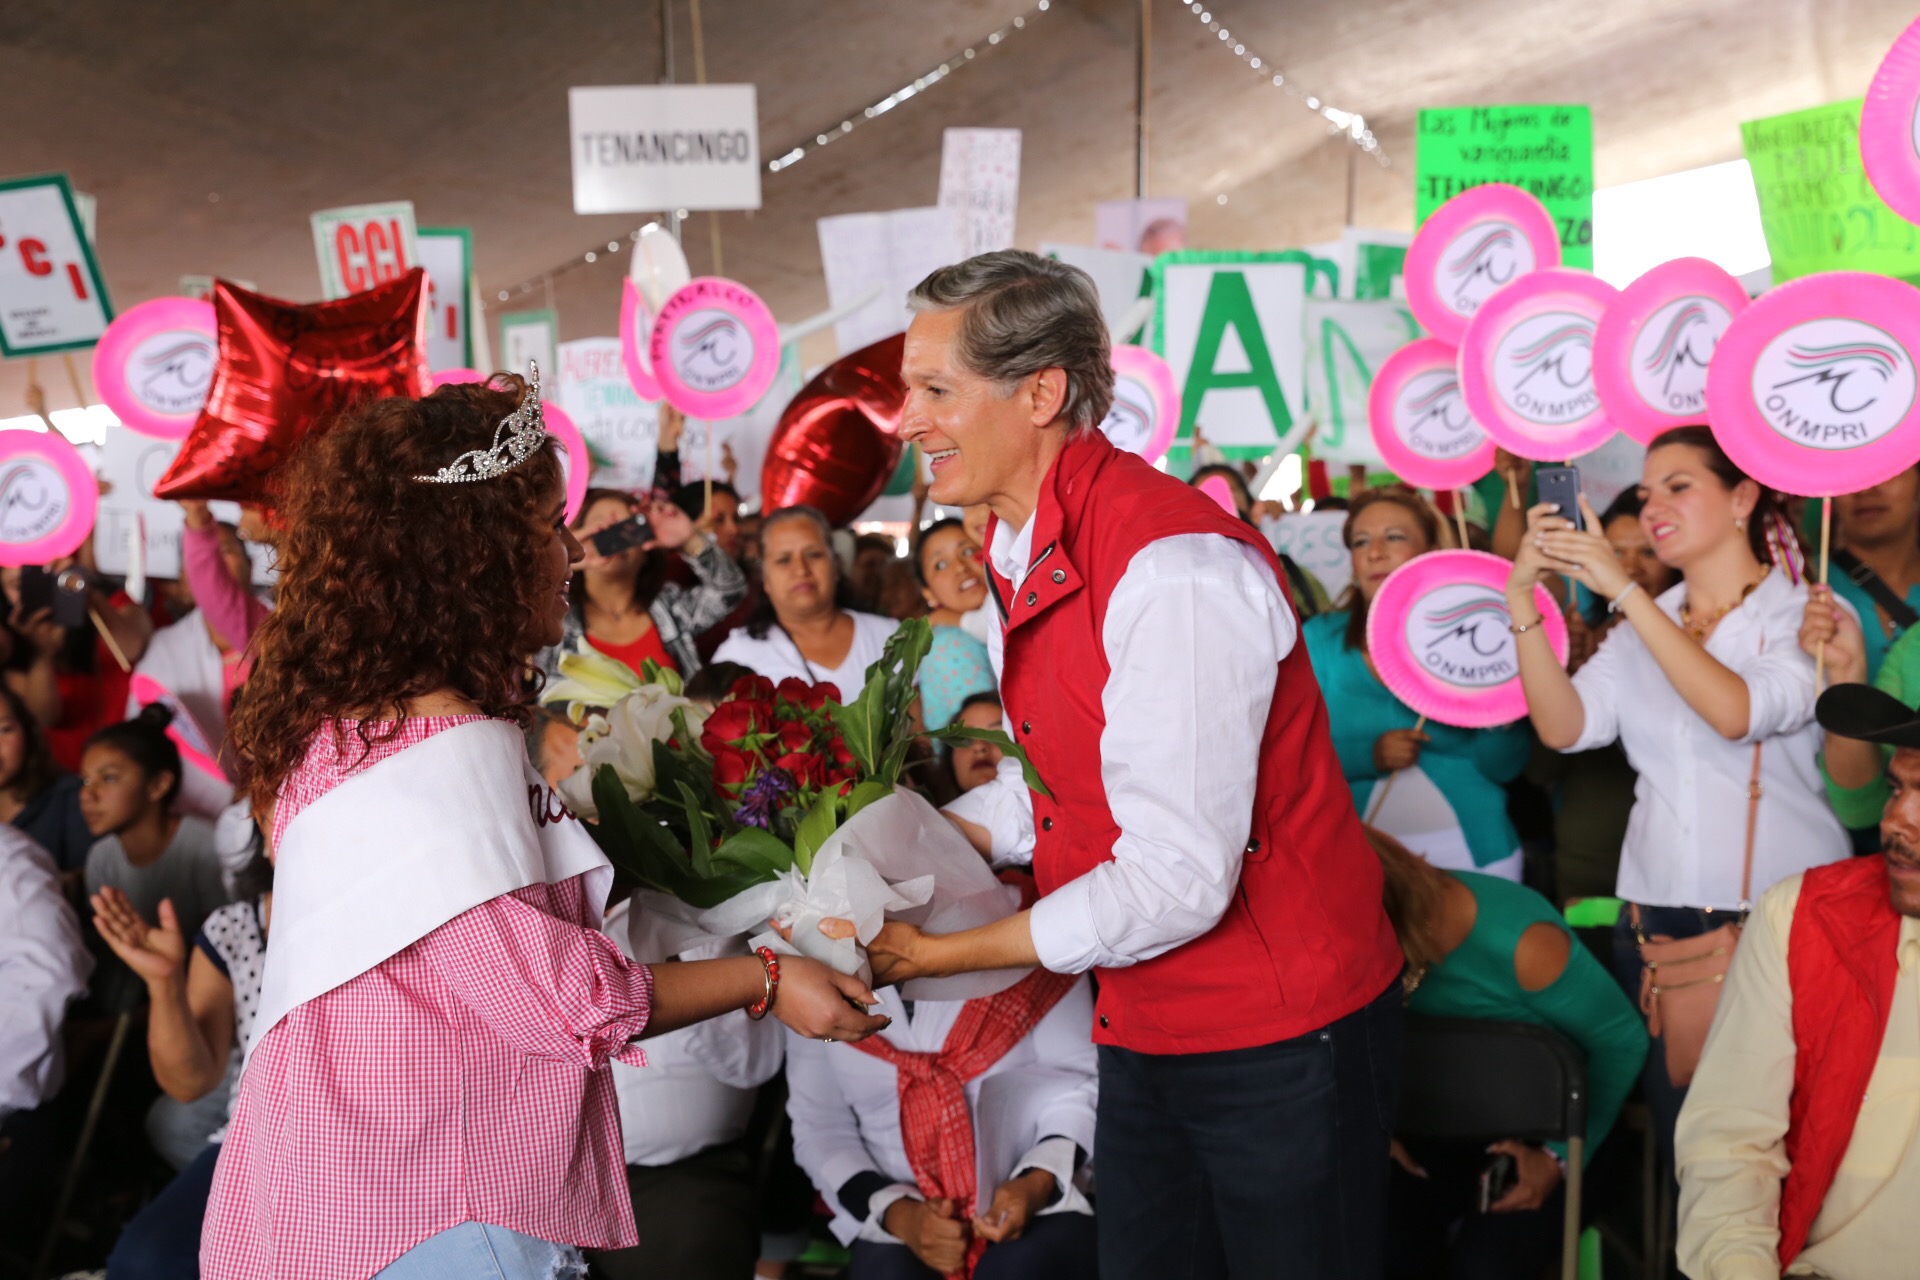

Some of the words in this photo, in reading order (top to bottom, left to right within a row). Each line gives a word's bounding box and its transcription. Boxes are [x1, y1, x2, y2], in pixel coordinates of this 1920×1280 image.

[580, 129, 749, 167] TENANCINGO
[0, 233, 88, 300] CI
[1765, 394, 1868, 442] ONMPRI
[1425, 651, 1514, 680] ONMPRI
